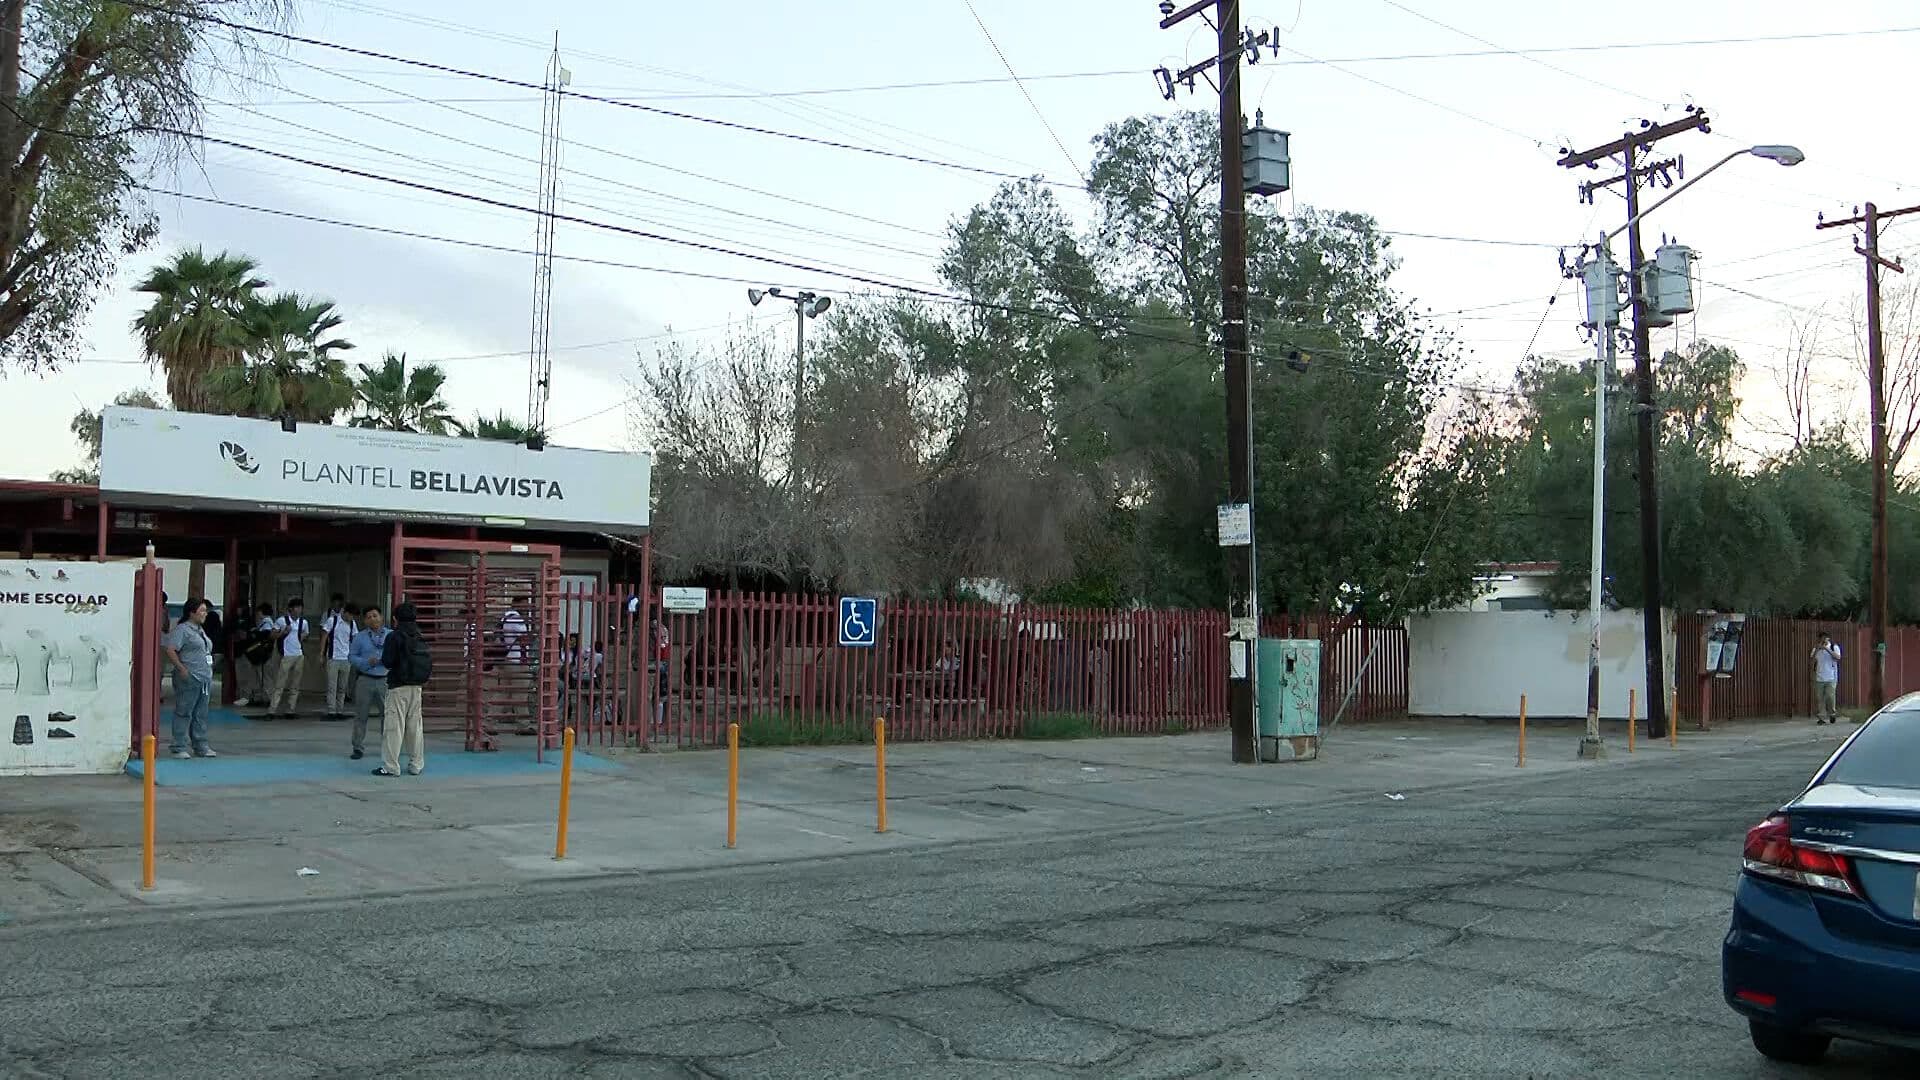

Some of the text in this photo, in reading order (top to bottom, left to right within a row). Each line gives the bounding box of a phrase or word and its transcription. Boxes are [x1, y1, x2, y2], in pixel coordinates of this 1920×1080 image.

[282, 458, 564, 500] PLANTEL BELLAVISTA
[35, 592, 108, 606] ESCOLAR
